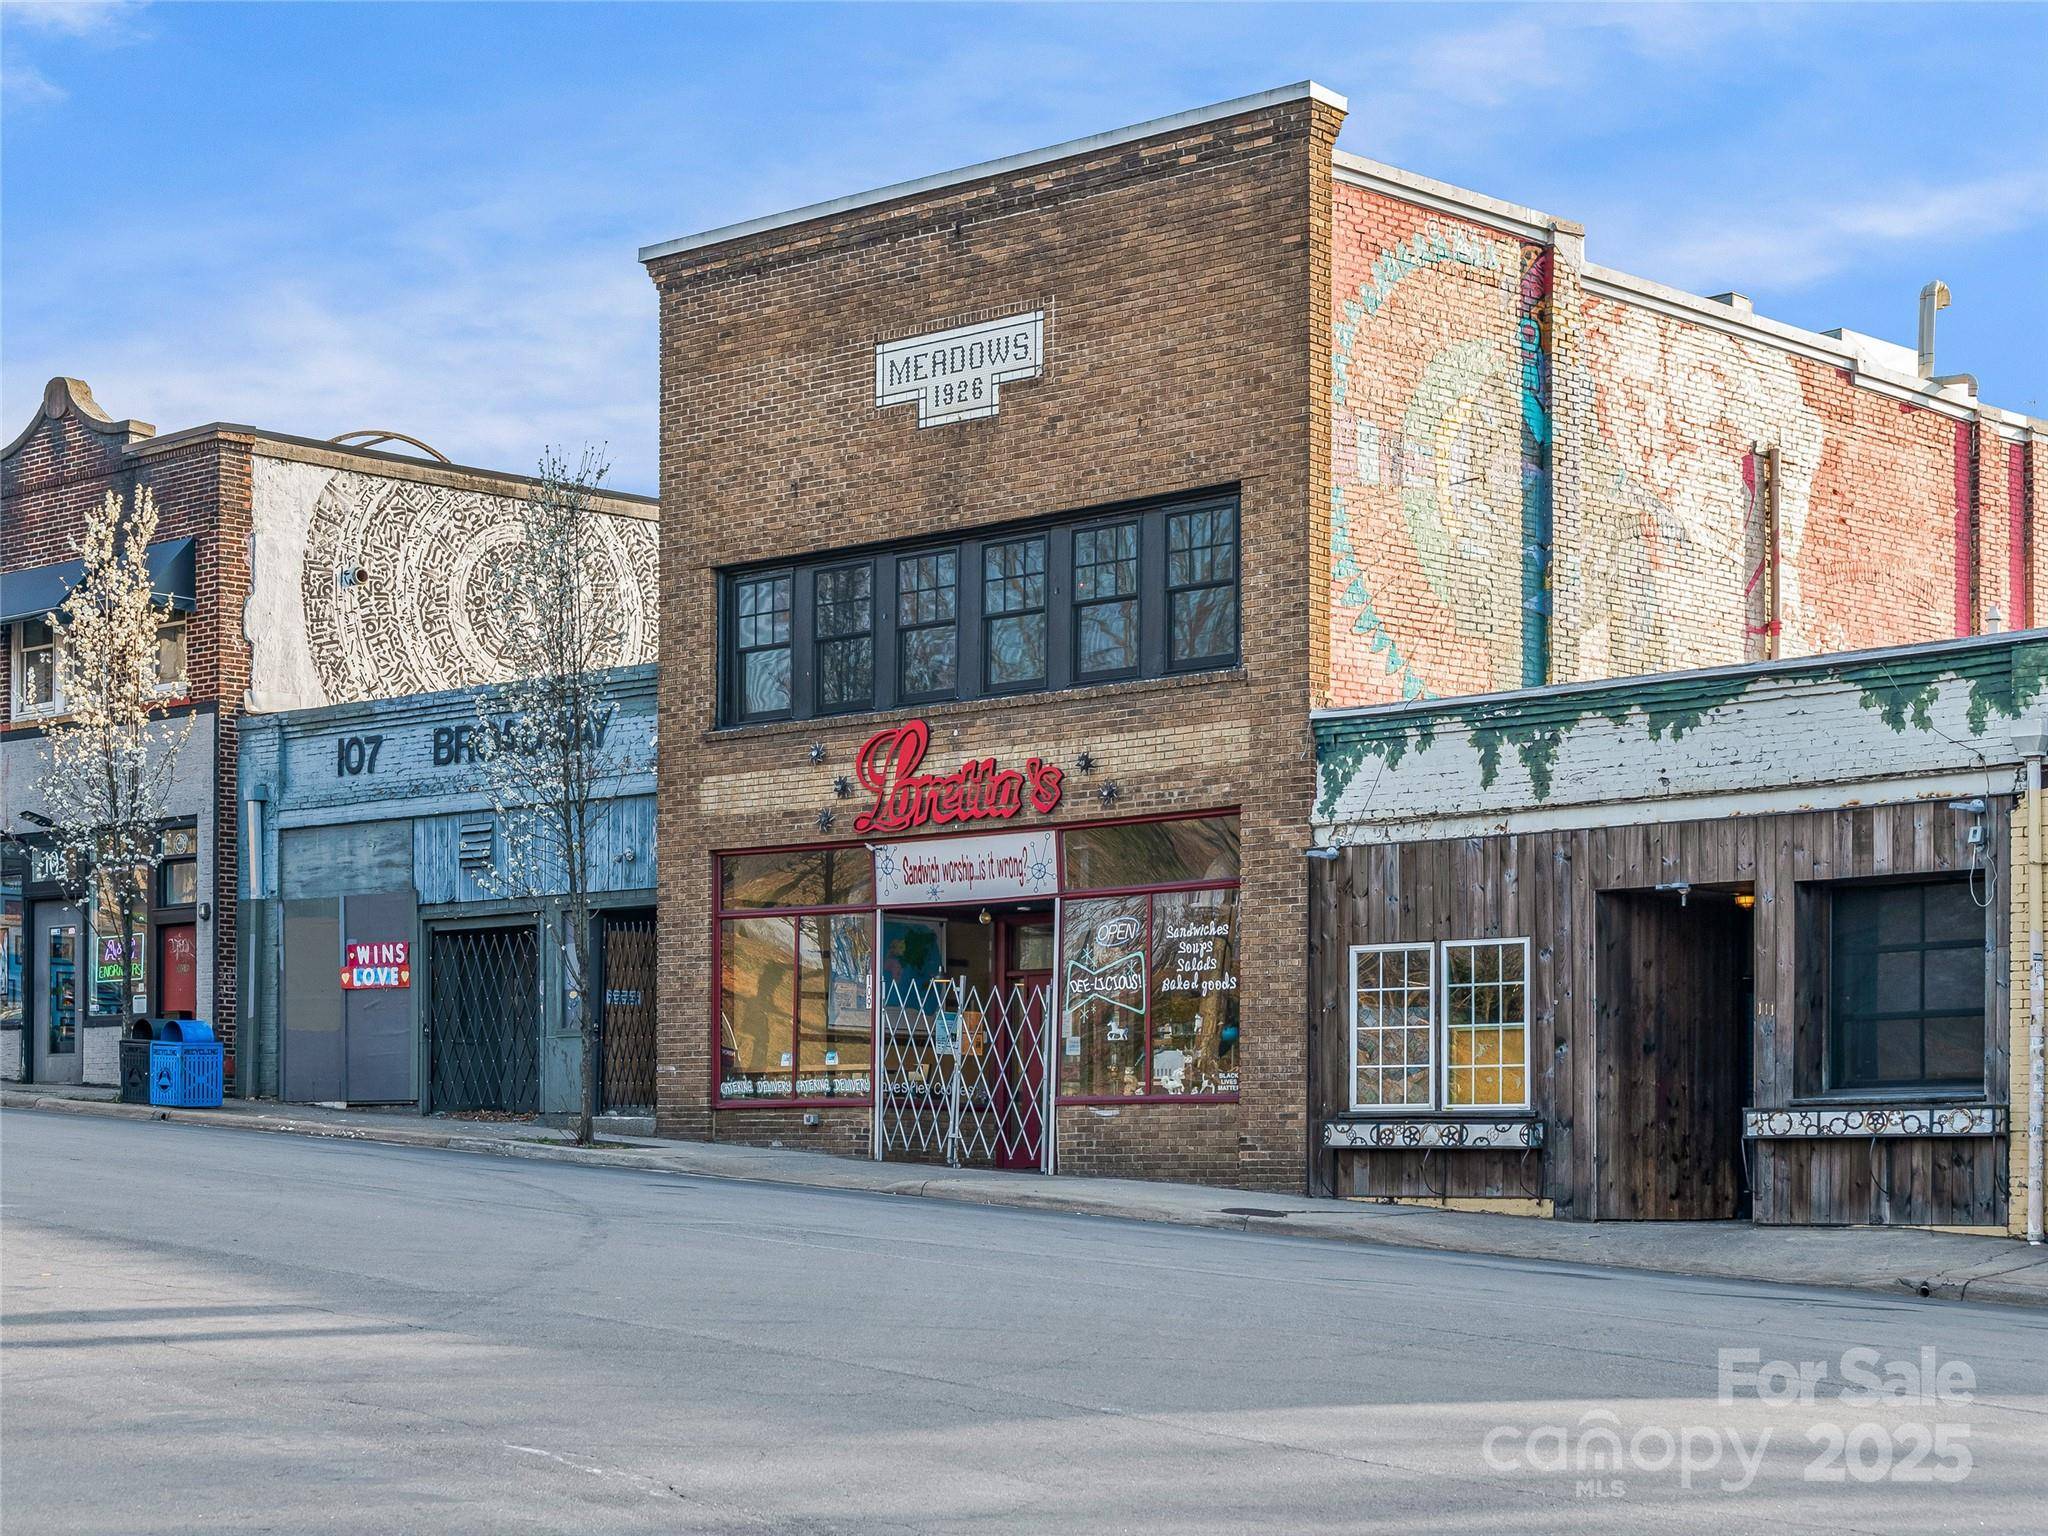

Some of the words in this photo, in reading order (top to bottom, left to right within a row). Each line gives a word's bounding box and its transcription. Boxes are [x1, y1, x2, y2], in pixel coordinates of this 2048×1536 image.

[934, 377, 983, 407] 1926
[337, 735, 383, 776] 107
[854, 719, 1064, 834] Loretta's
[902, 855, 940, 886] Sandwich
[997, 846, 1028, 887] wrong?
[1097, 923, 1137, 942] OPEN
[1166, 920, 1230, 939] Sandwiches
[356, 943, 405, 965] WINS
[98, 962, 142, 979] ENGRARS
[353, 966, 399, 987] LOVE
[1069, 973, 1142, 993] DEE-LICIOUS!
[1201, 971, 1238, 997] goods
[933, 1082, 974, 1096] Cooes
